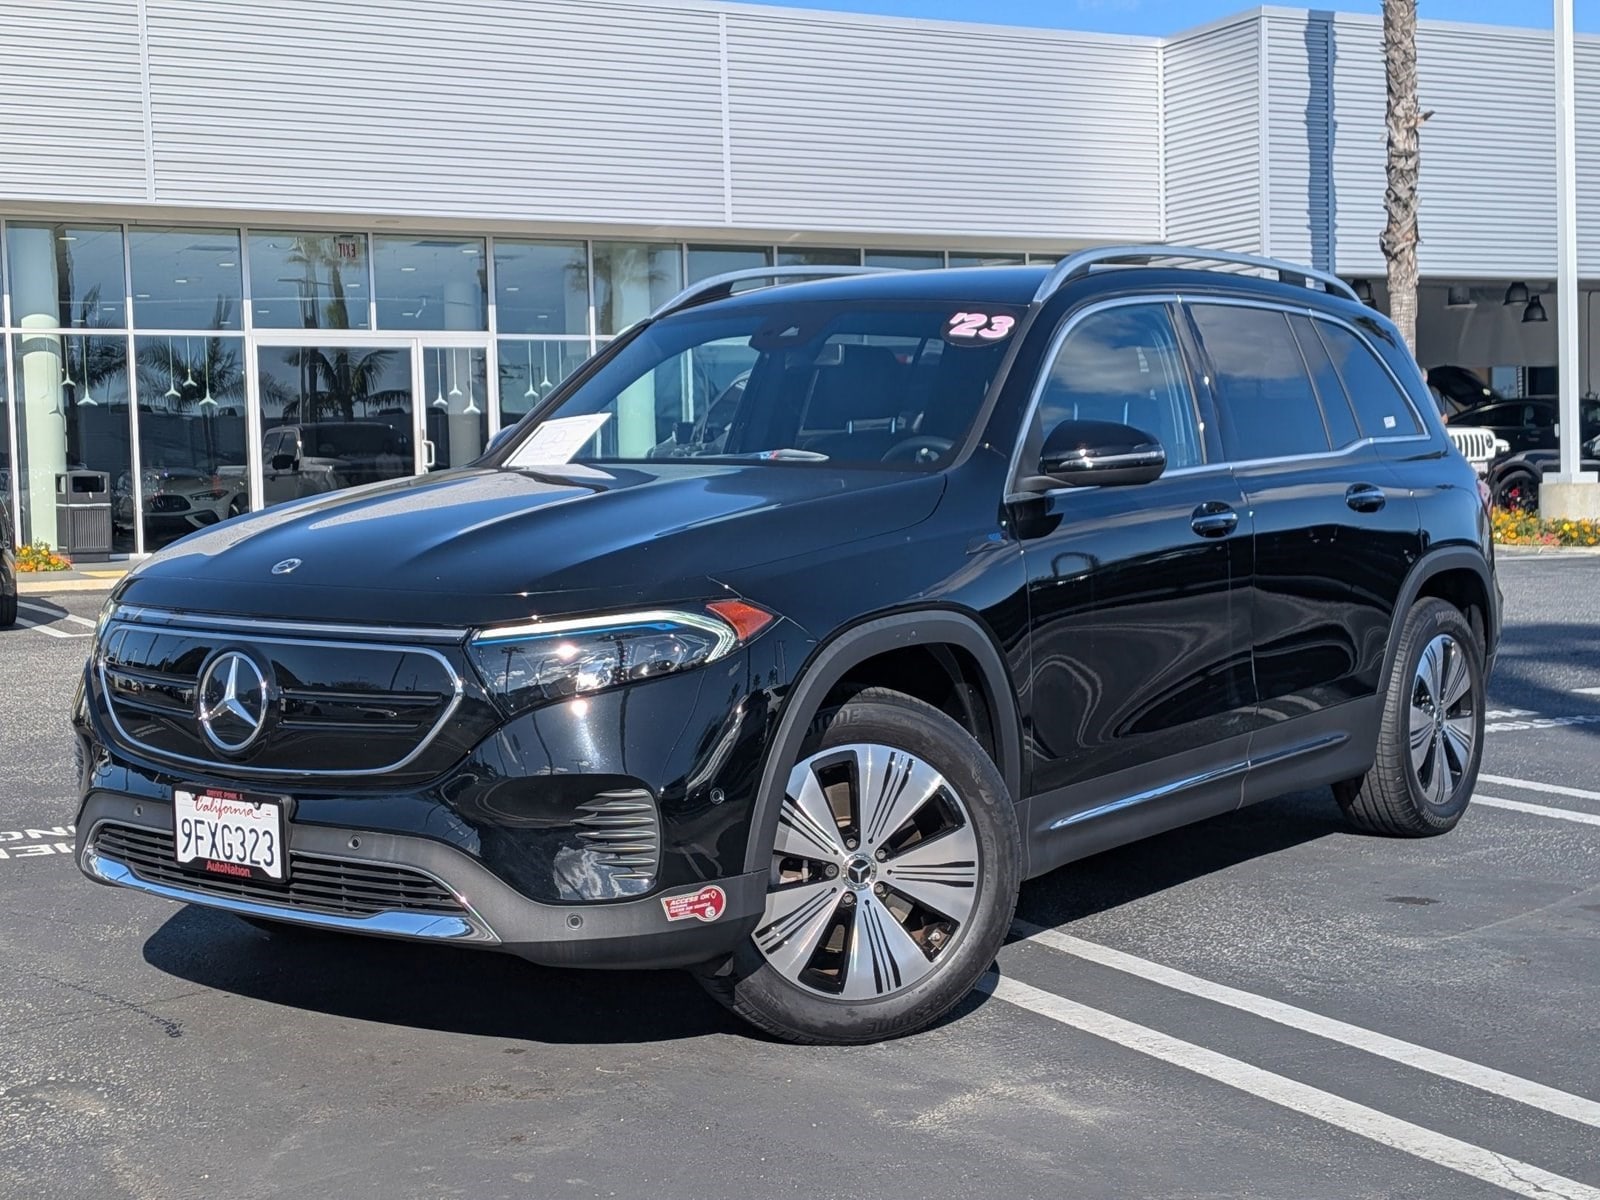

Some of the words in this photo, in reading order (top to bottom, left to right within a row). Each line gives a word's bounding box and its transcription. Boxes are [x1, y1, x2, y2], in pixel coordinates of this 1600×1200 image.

[195, 796, 261, 820] California
[181, 818, 275, 867] 9FXG323
[206, 860, 251, 877] AutoNation
